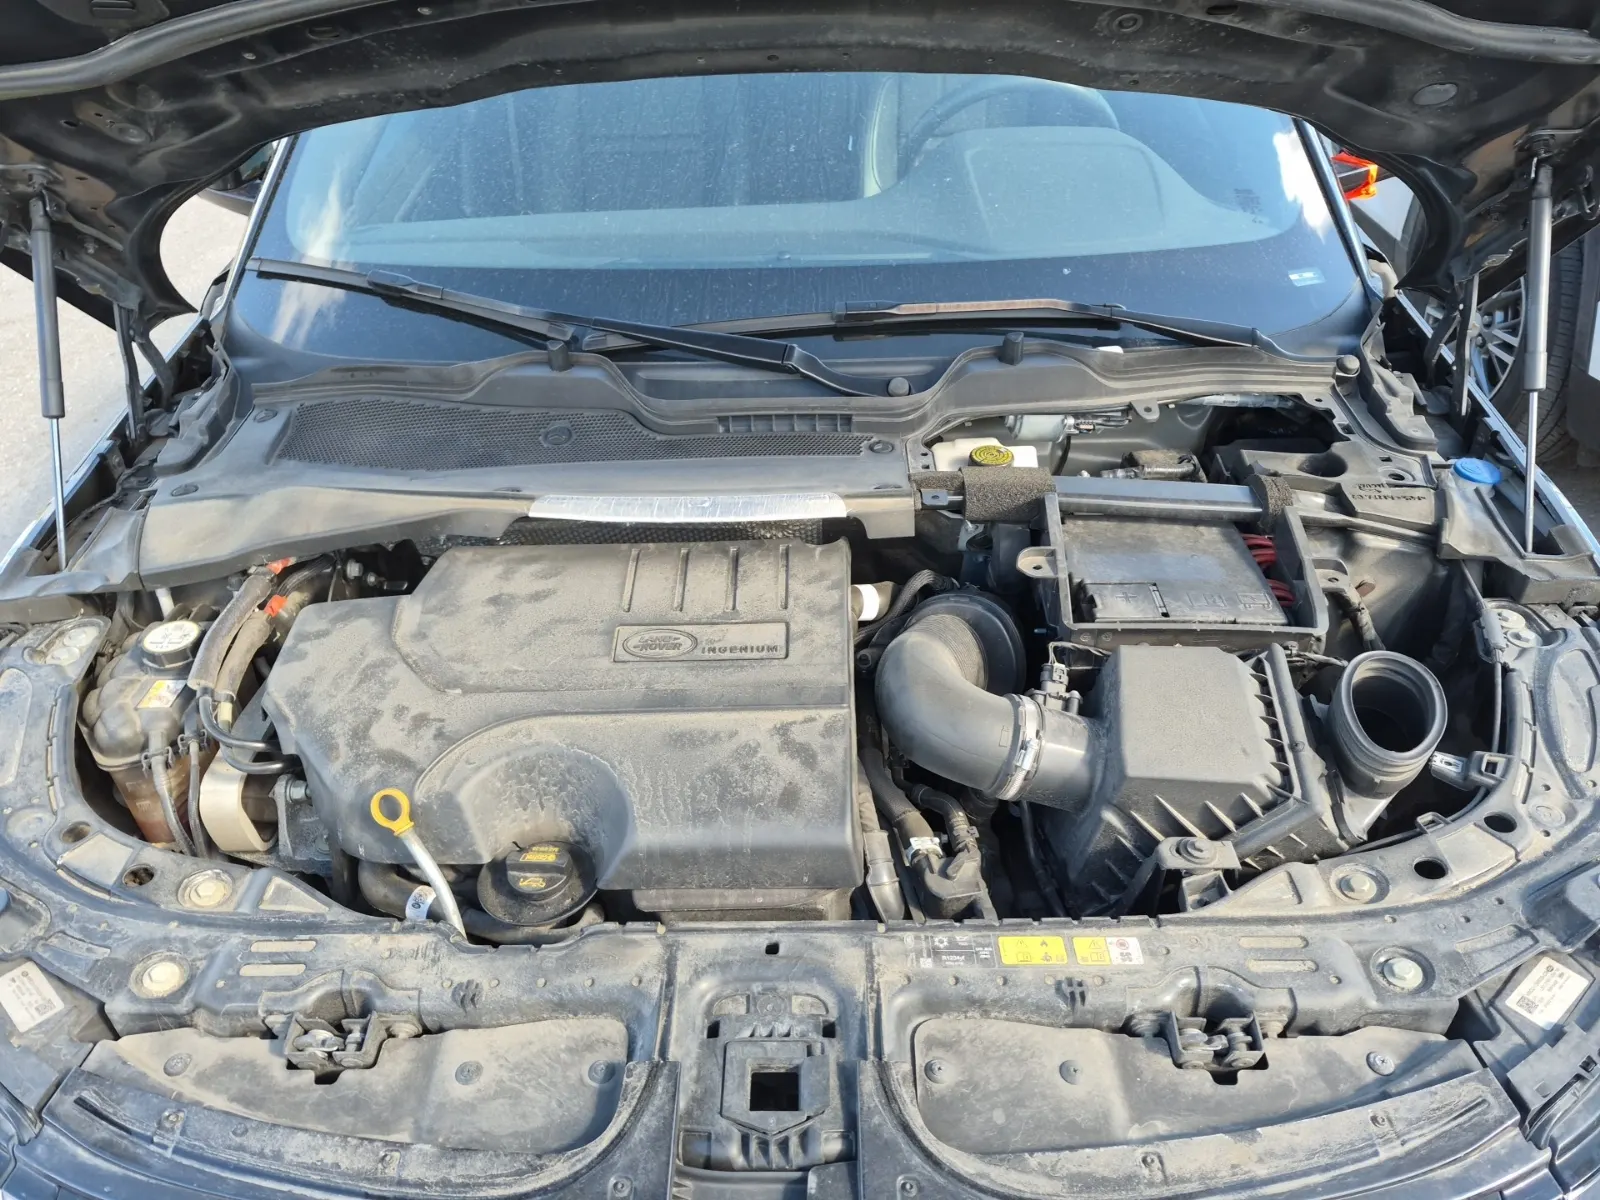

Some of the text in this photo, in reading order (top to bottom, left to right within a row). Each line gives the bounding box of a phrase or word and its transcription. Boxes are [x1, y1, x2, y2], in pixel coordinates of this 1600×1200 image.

[639, 635, 673, 643] LAND
[640, 643, 682, 651] ROVER
[701, 646, 779, 655] INGENIUM
